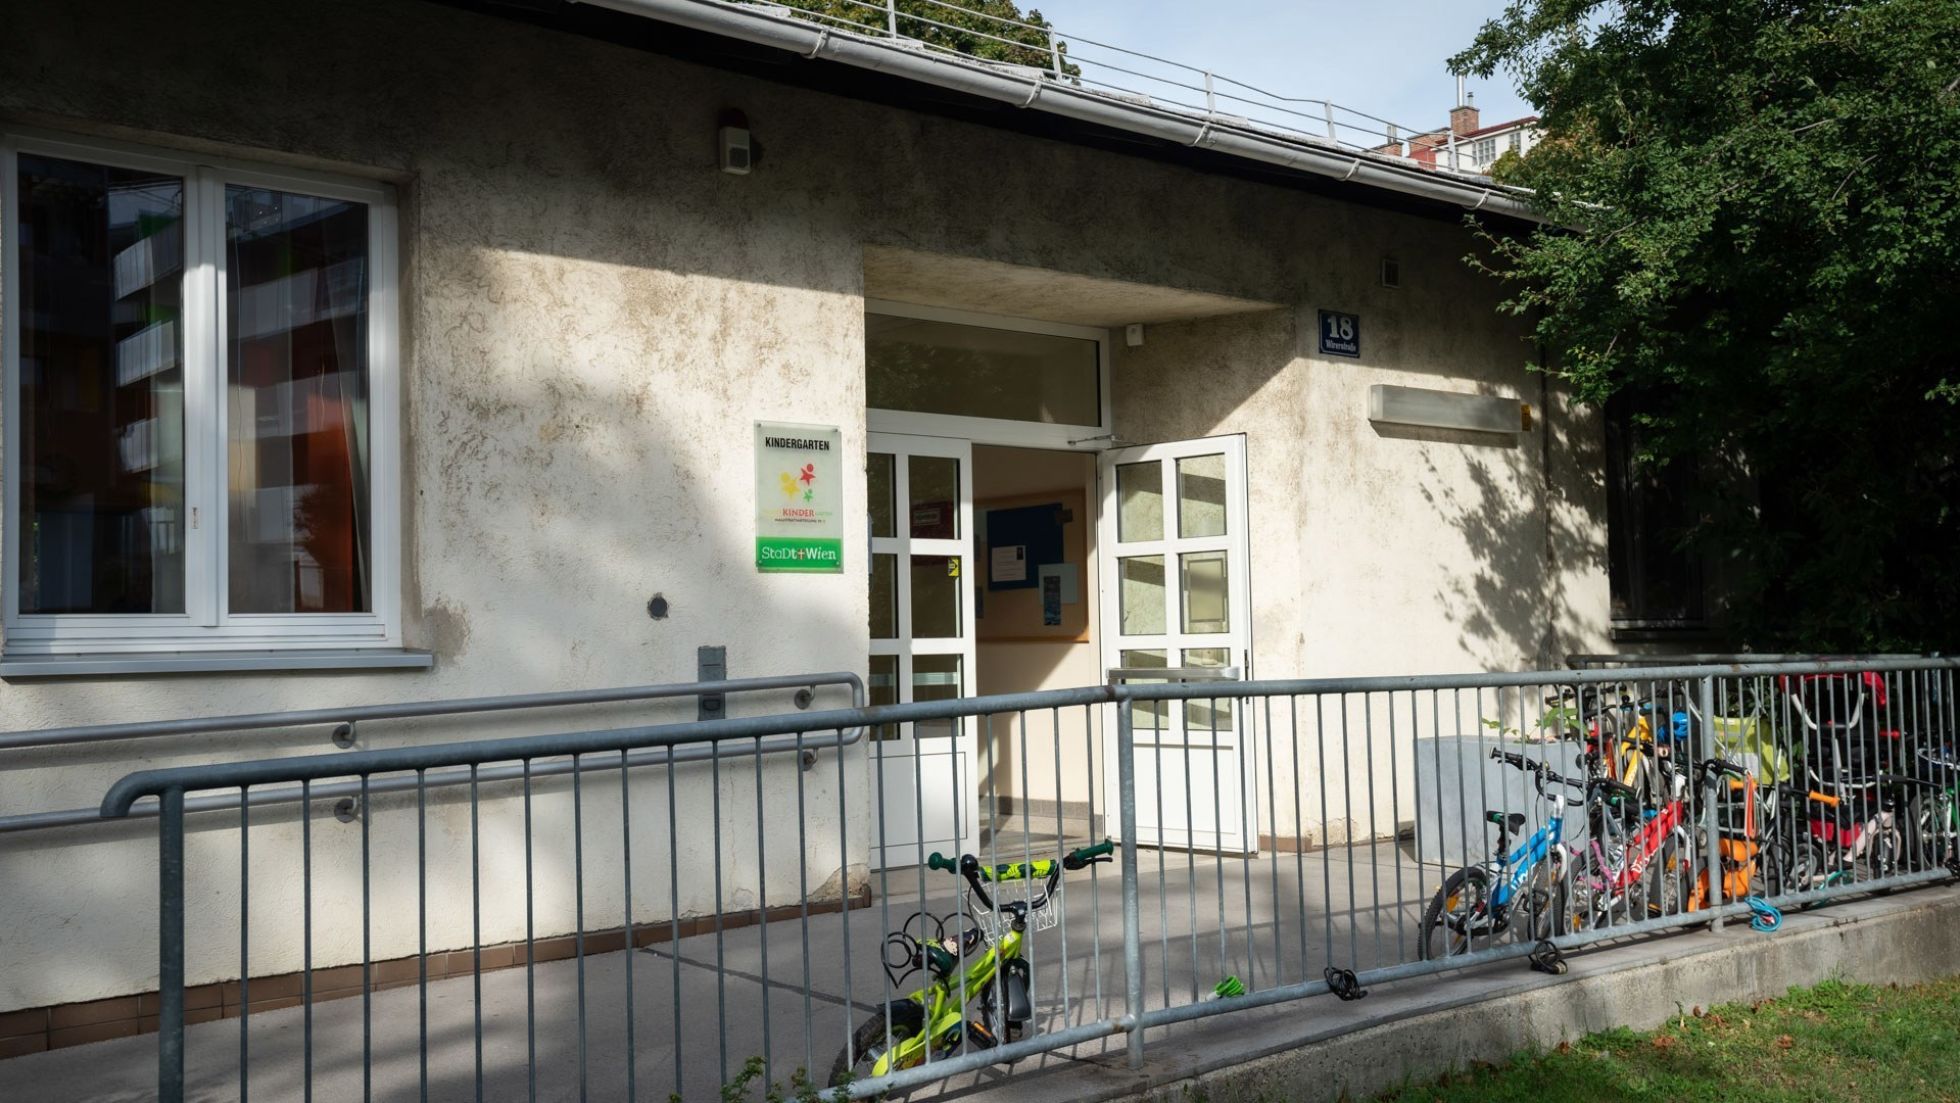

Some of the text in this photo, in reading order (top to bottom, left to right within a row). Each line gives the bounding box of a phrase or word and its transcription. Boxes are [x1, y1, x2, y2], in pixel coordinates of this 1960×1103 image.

[1328, 315, 1354, 340] 18
[765, 436, 830, 451] KINDERGARTEN
[805, 546, 837, 560] Wien
